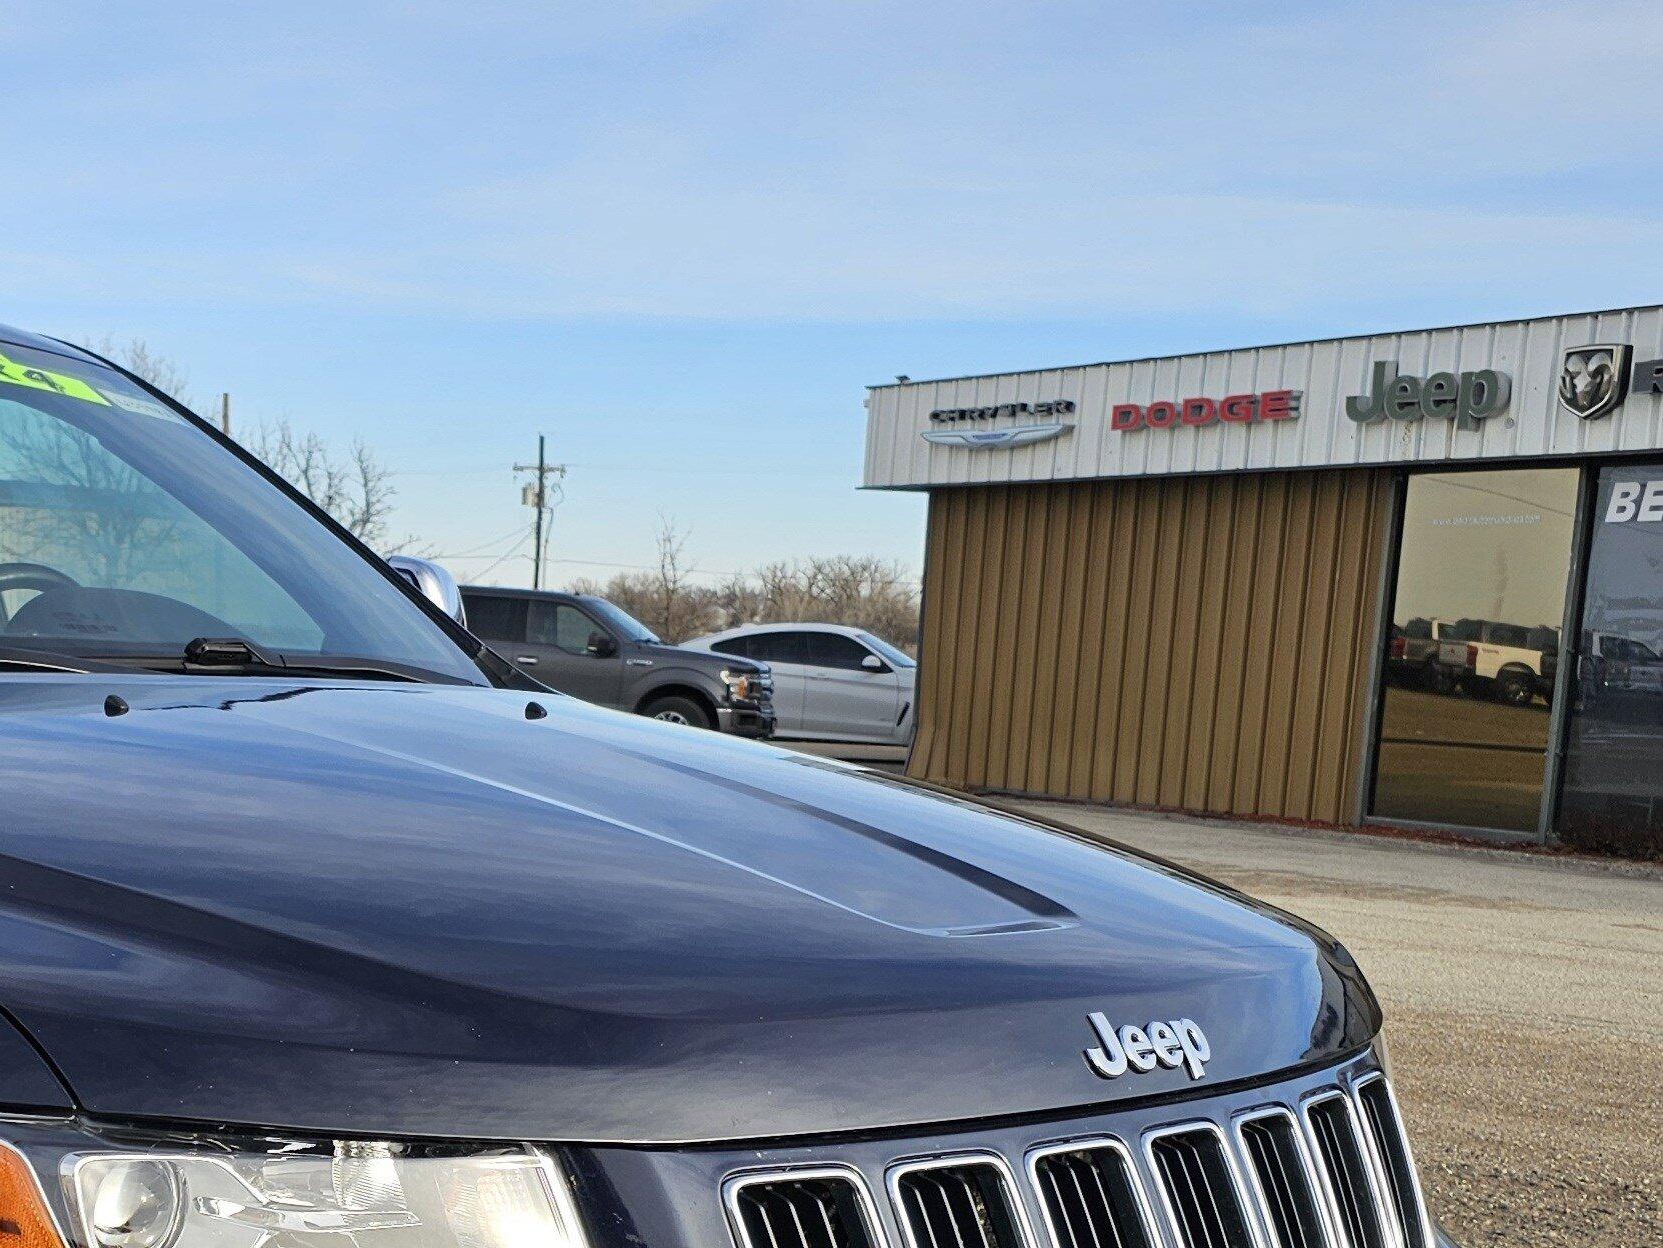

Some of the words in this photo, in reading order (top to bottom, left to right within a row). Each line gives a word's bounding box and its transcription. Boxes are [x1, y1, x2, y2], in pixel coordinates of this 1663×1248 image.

[1111, 390, 1303, 431] DODGE
[1345, 360, 1511, 432] Jeep
[1082, 1011, 1211, 1080] Jeep
